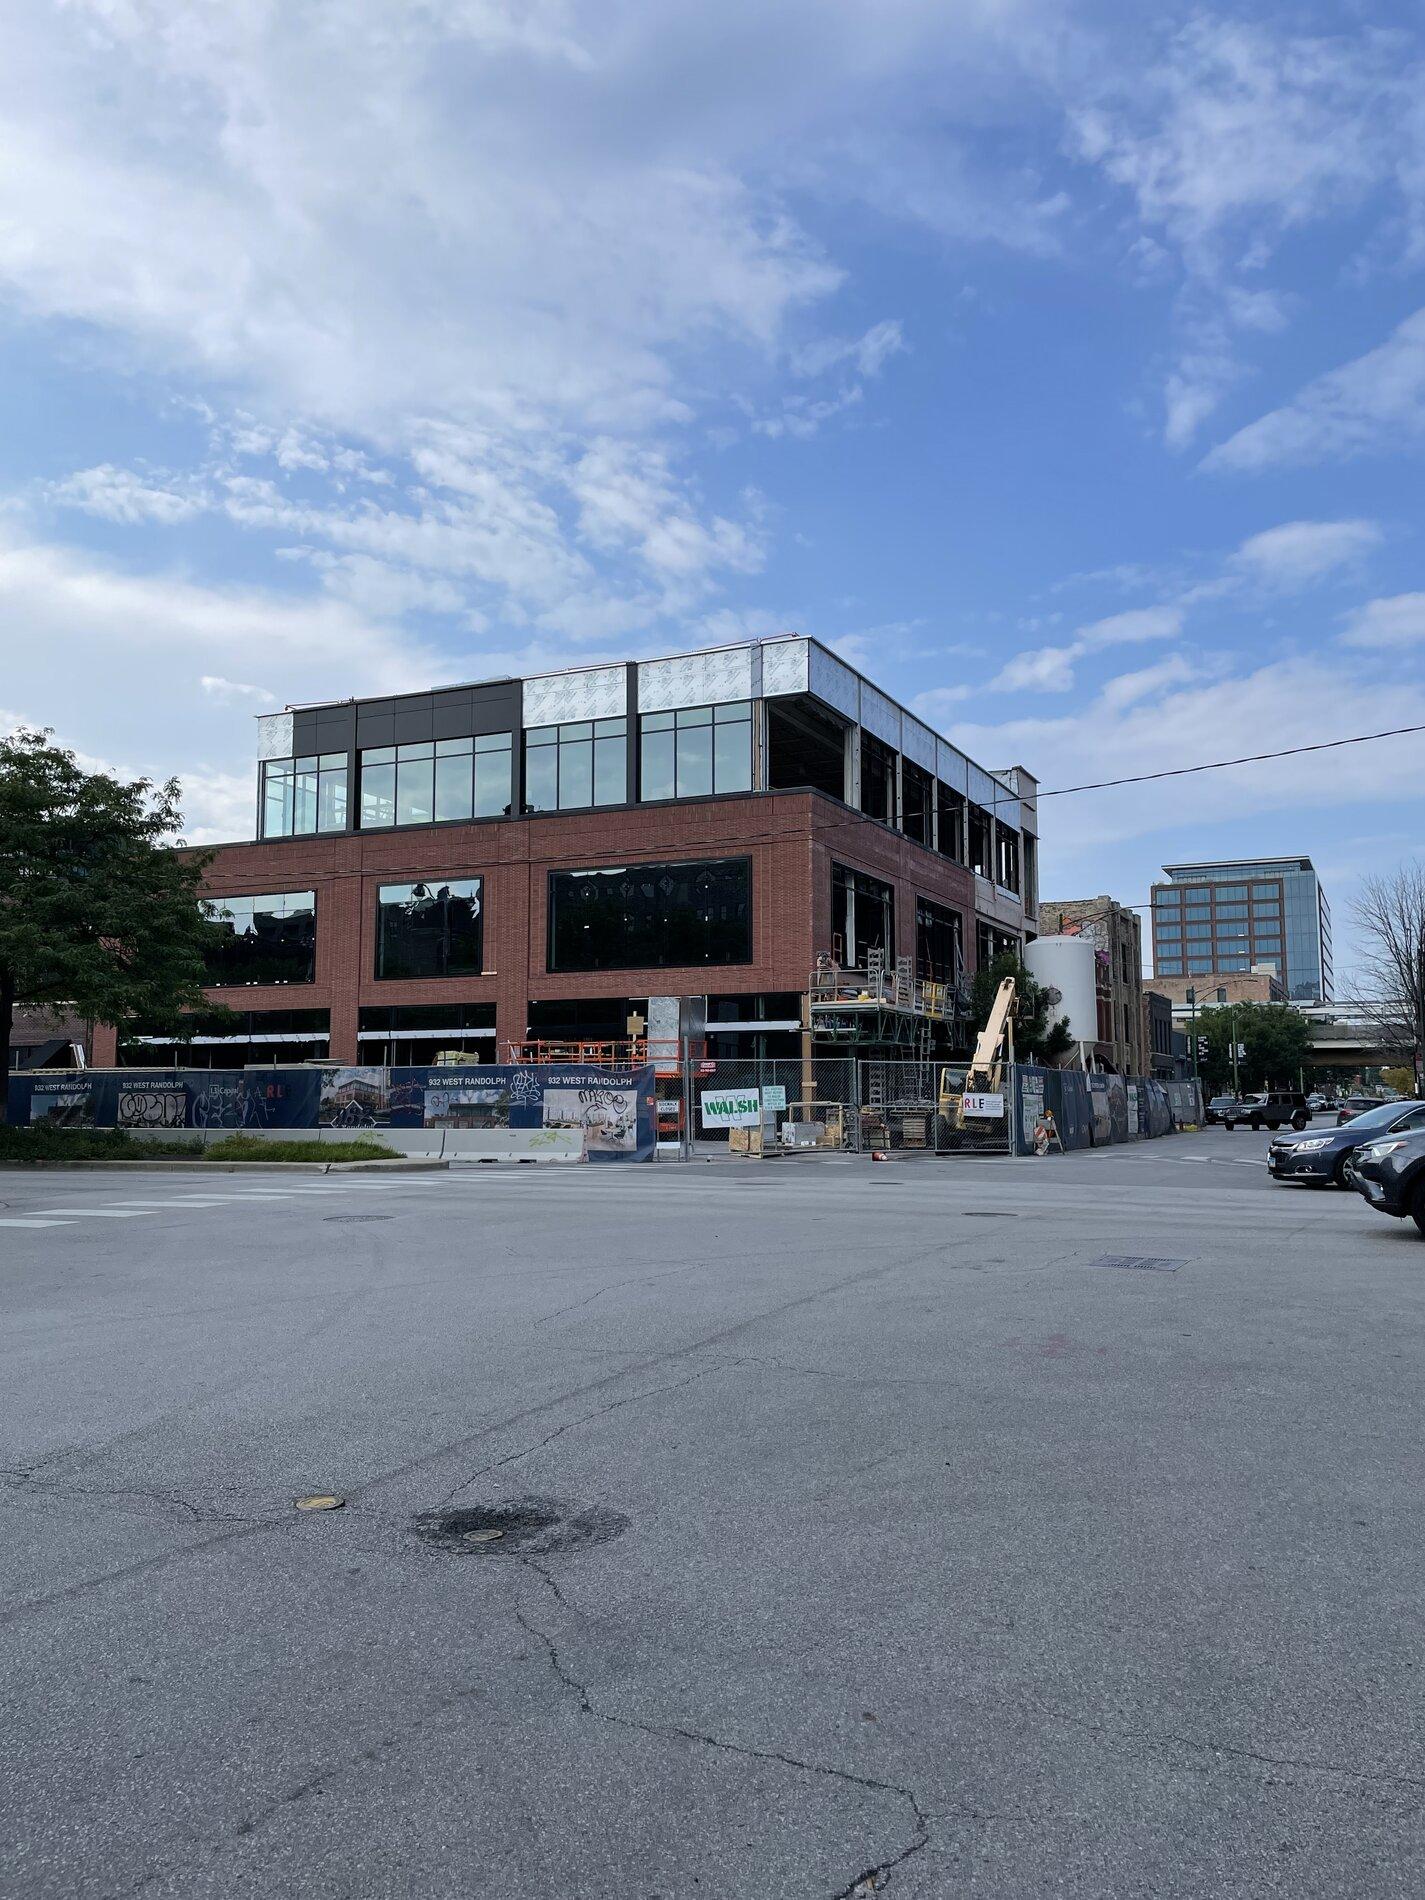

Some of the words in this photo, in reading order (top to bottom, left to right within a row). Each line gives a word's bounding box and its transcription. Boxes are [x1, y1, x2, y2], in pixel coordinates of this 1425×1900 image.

[133, 1081, 149, 1089] WEST
[150, 1081, 184, 1089] RANDOLPH
[428, 1078, 441, 1086] 932
[443, 1078, 463, 1086] WEST
[465, 1077, 507, 1085] RANDOLPH
[548, 1077, 560, 1085] 932
[562, 1076, 585, 1085] WEST
[587, 1077, 632, 1086] RANDOLPH
[60, 1082, 92, 1090] RANDOLPH
[704, 1099, 759, 1115] WALSH
[964, 1098, 985, 1108] RLE
